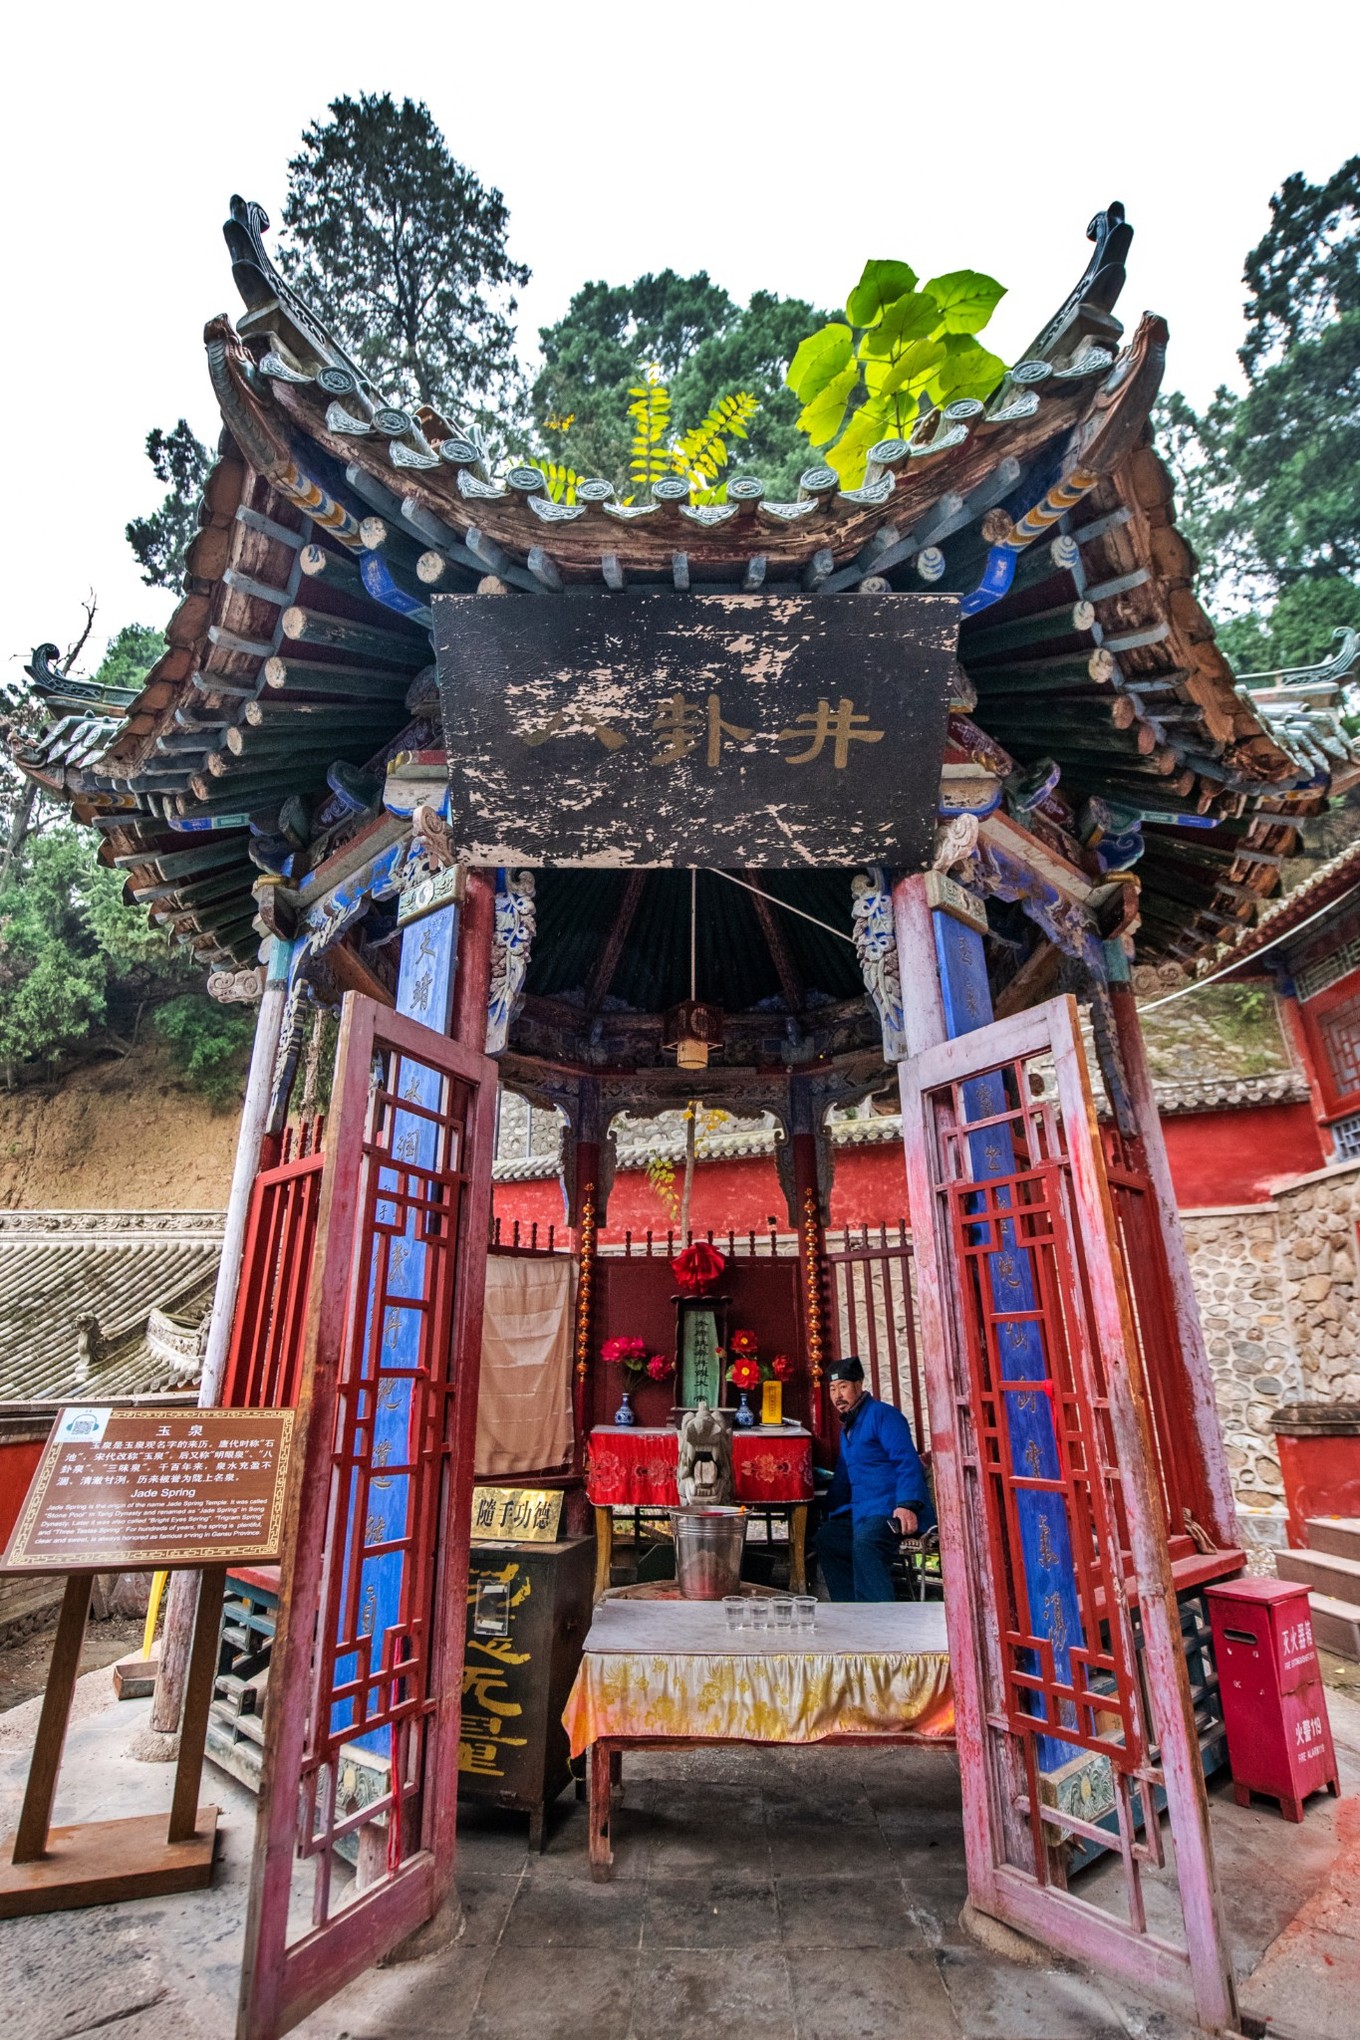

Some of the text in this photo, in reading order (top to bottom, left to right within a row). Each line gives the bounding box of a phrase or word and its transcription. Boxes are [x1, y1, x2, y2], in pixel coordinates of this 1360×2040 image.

[523, 692, 886, 768] 八卦井
[130, 1488, 196, 1498] Jade Spring
[114, 1510, 143, 1518] Dynasty
[476, 1498, 552, 1530] 隨手功德
[1281, 1619, 1313, 1656] 灭火器箱
